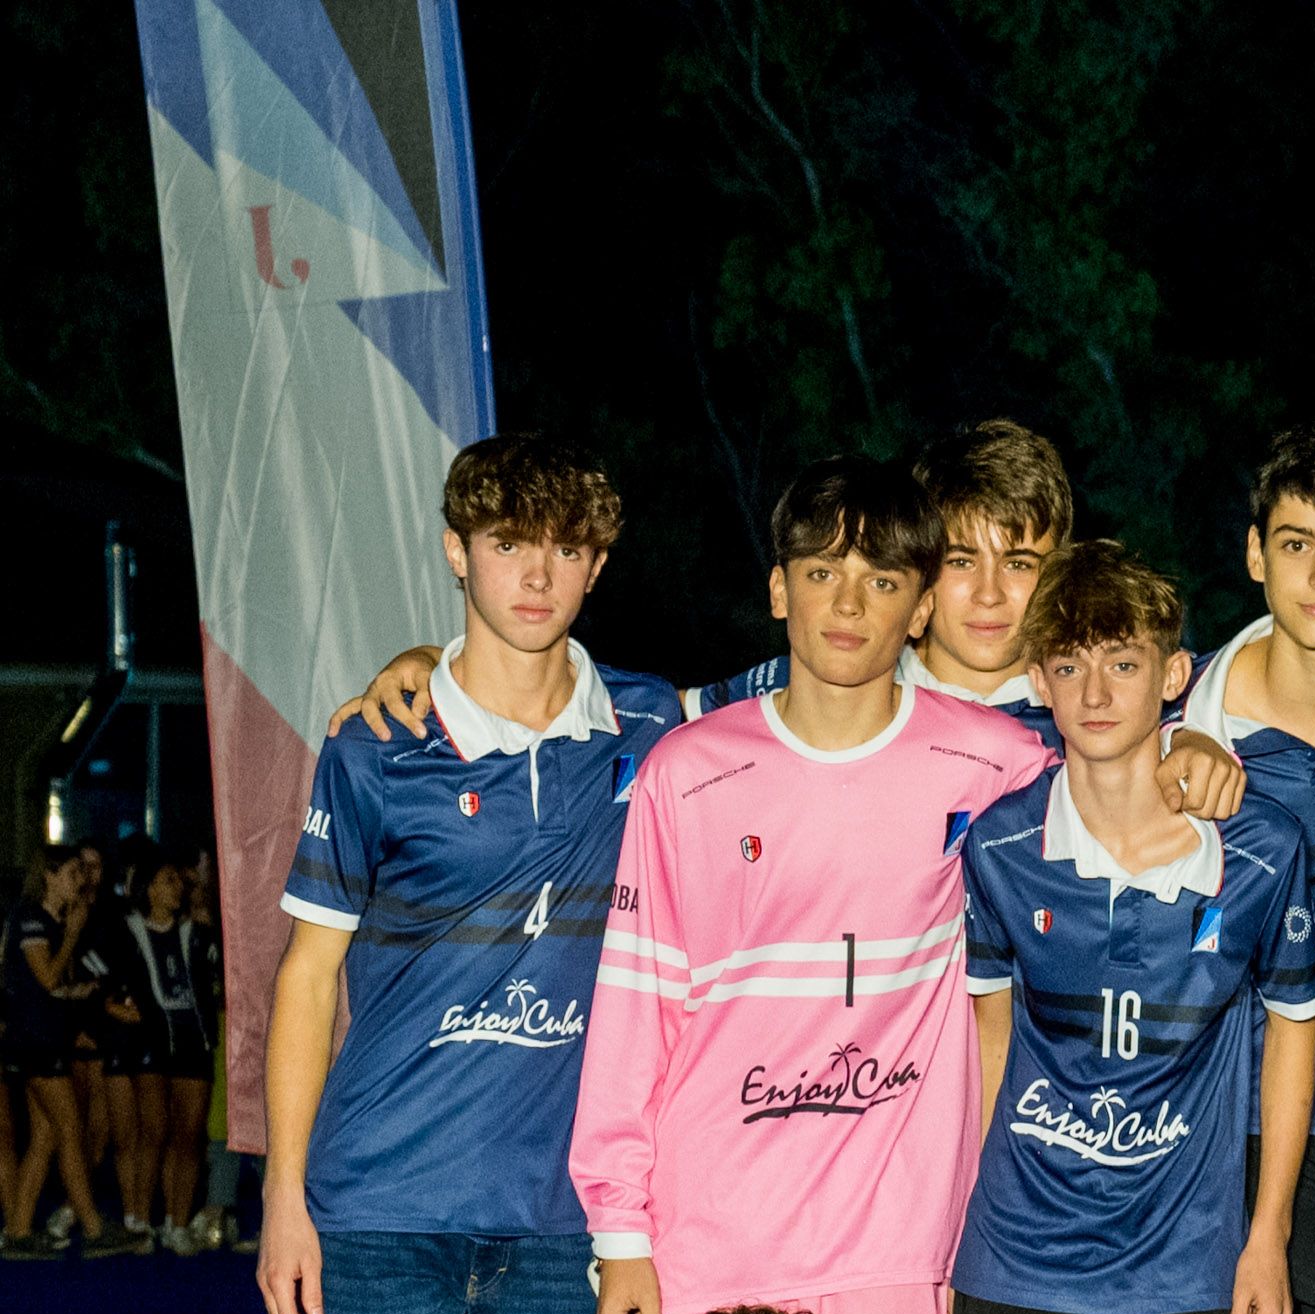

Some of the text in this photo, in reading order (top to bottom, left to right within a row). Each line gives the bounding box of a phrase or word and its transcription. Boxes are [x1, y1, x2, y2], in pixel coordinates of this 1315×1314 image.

[681, 761, 756, 799] PORSCHE
[929, 745, 1004, 773] PORSCHE
[524, 881, 553, 940] 4
[842, 933, 855, 1007] 1
[438, 998, 585, 1042] Enjoy Cuba
[1101, 988, 1142, 1061] 16
[741, 1064, 847, 1117] Enjoy
[1015, 1078, 1190, 1152] Enjoy Cuba
